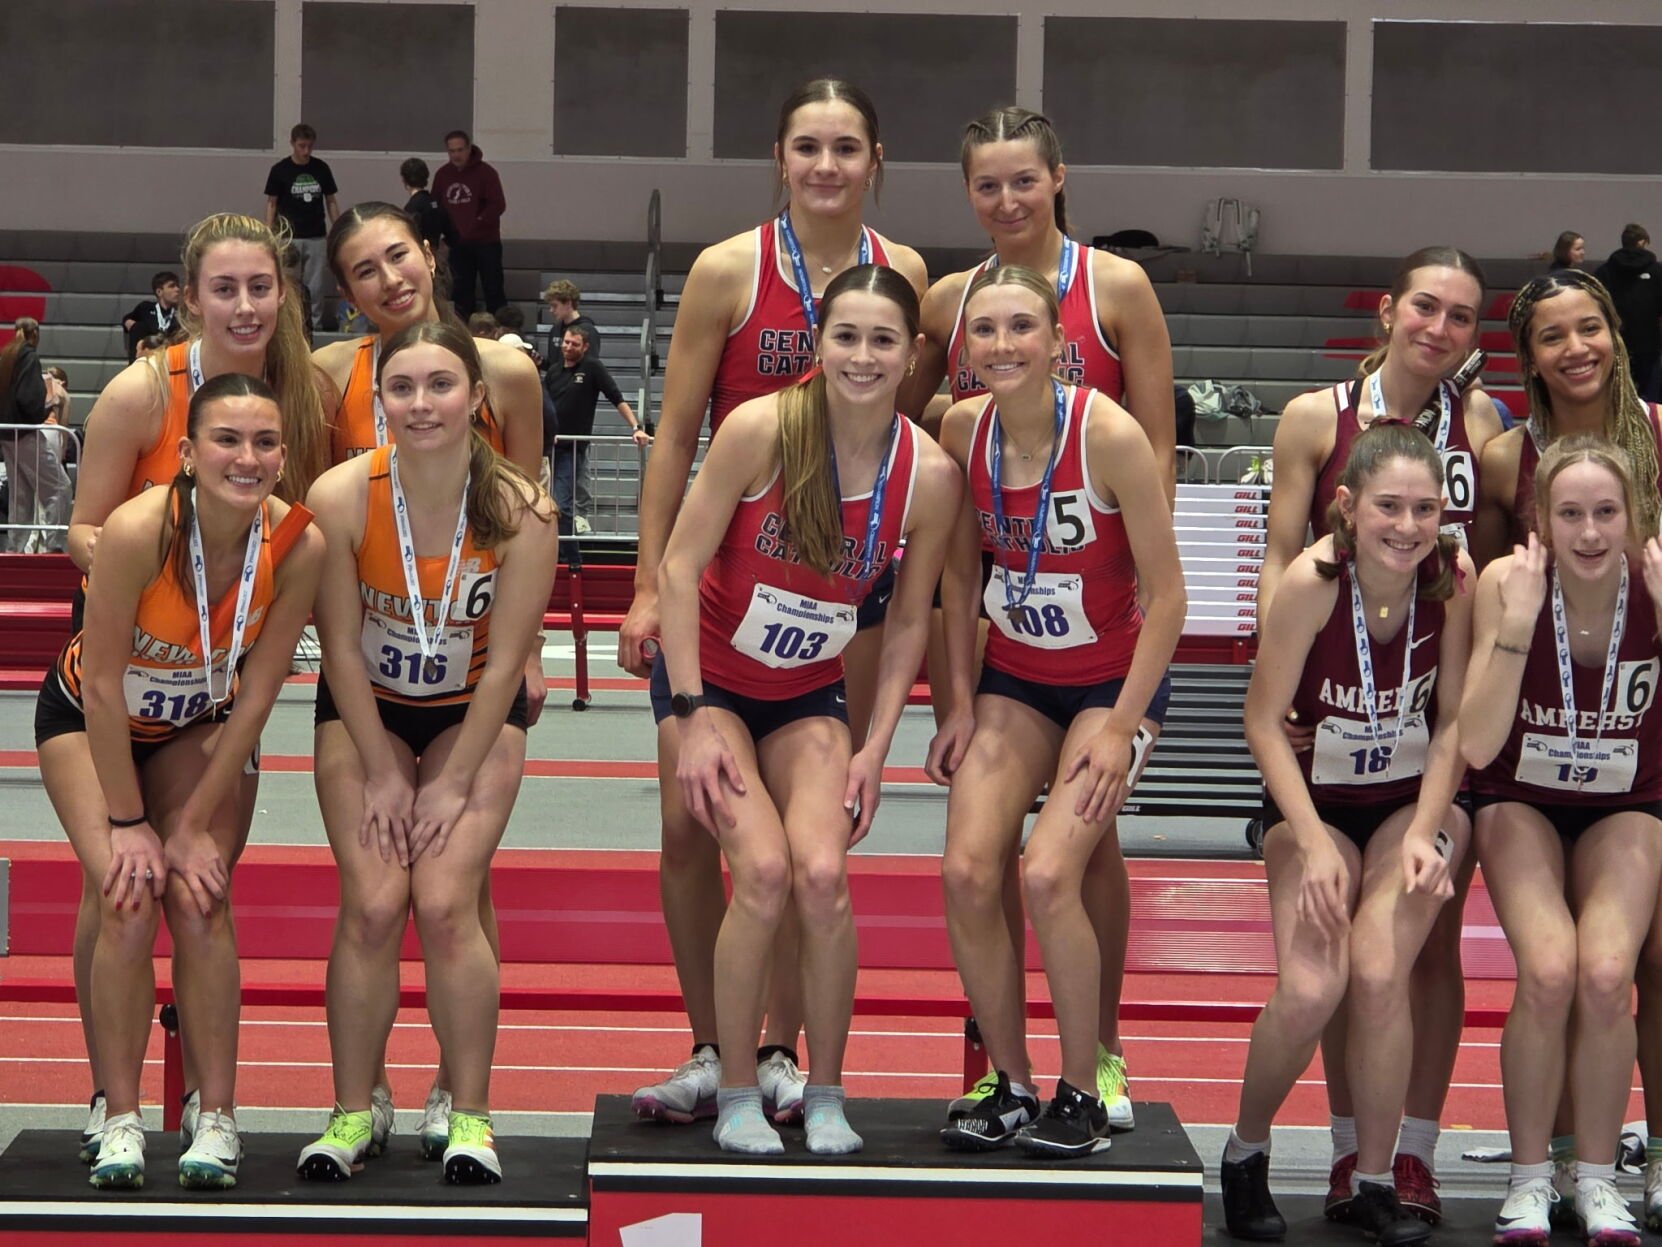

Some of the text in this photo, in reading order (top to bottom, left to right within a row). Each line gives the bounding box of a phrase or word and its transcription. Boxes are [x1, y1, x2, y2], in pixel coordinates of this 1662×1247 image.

[759, 328, 816, 353] CEN
[757, 353, 811, 376] CAT
[1446, 455, 1470, 508] 6
[1234, 491, 1257, 500] GILL
[1053, 495, 1085, 546] 5
[1235, 505, 1258, 513] GILL
[1235, 520, 1258, 528] GILL
[1237, 534, 1260, 543] GILL
[1237, 549, 1260, 557] GILL
[466, 574, 492, 619] 6
[799, 600, 818, 611] MIAA
[776, 603, 834, 624] Championships
[1237, 609, 1256, 617] GIL
[1237, 623, 1256, 631] GIL
[759, 623, 829, 659] 103
[379, 645, 448, 685] 316
[1410, 675, 1432, 713] 6
[1626, 663, 1652, 713] 6
[139, 690, 210, 720] 318
[1349, 746, 1393, 775] 18
[1554, 763, 1599, 784] 19
